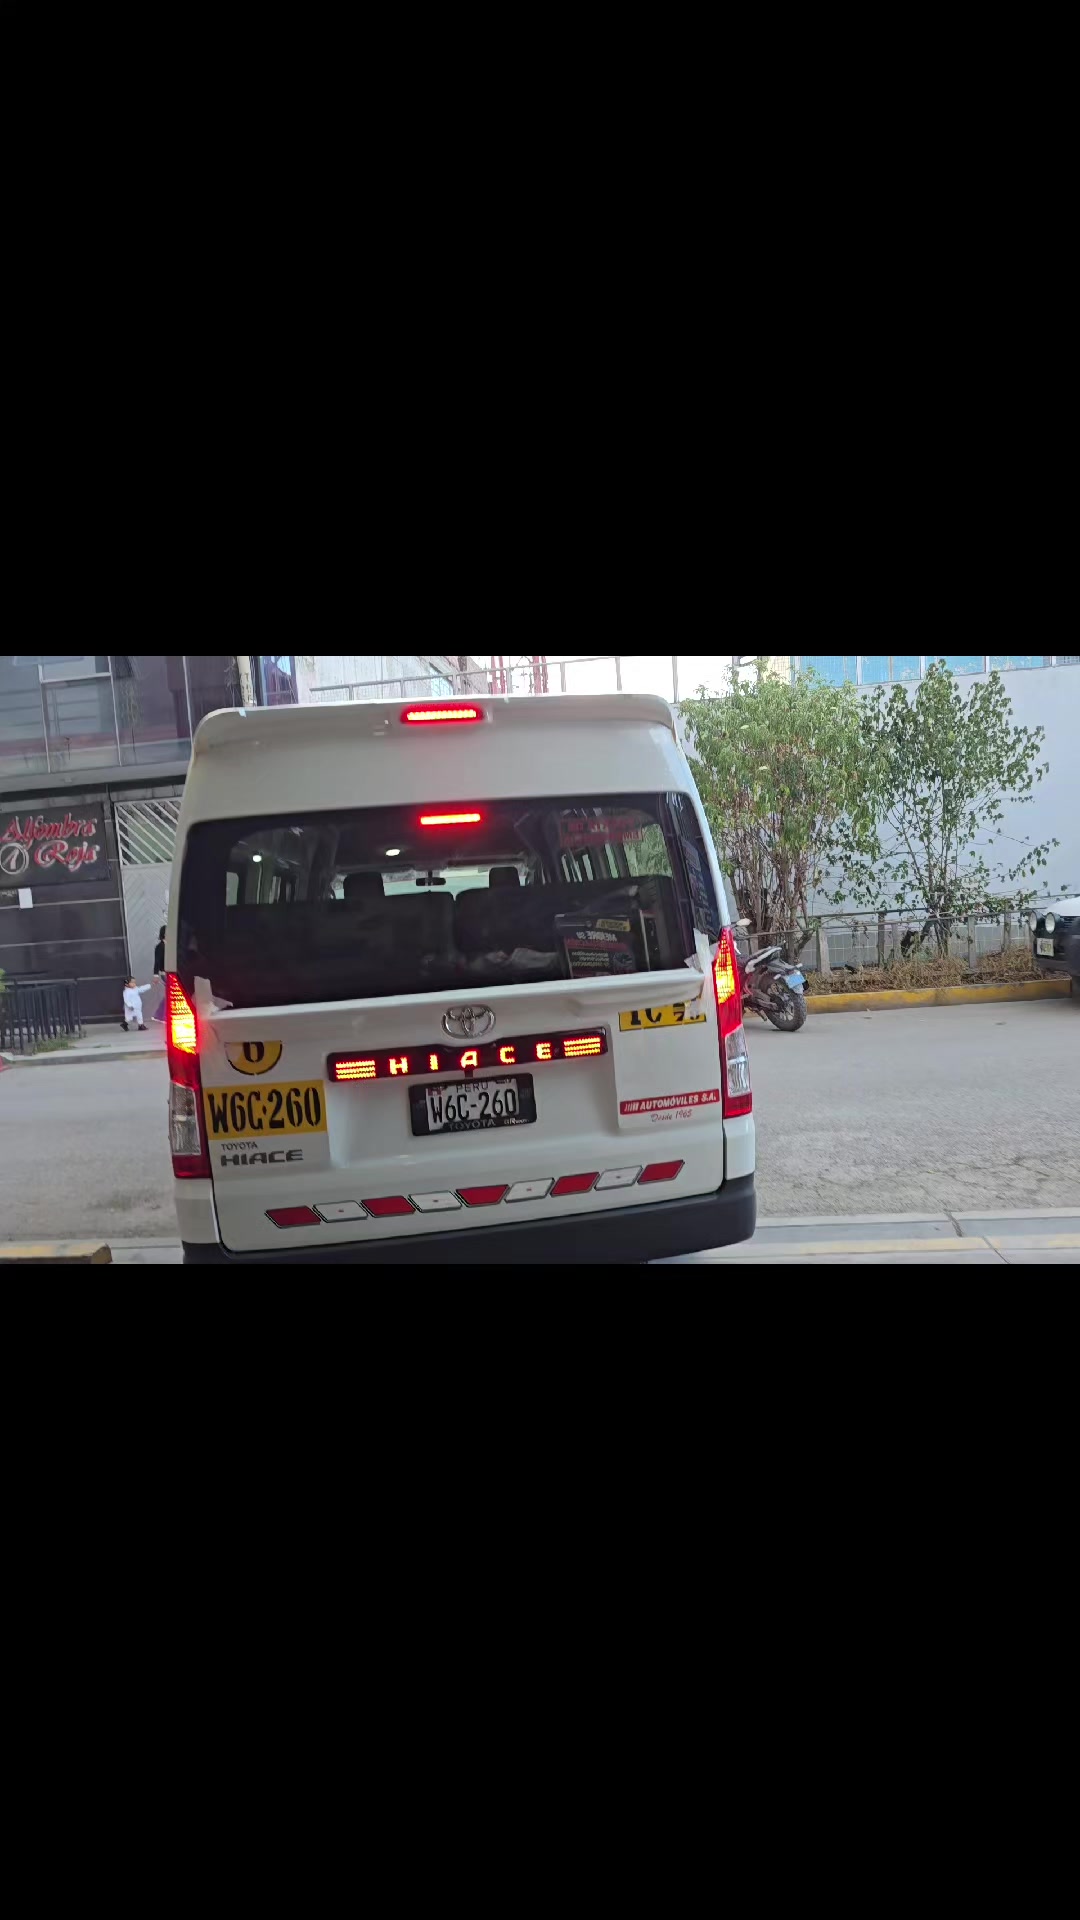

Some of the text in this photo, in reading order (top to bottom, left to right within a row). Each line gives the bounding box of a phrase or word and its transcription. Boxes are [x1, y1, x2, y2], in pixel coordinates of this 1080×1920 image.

[0, 813, 97, 850] Alfombra
[34, 840, 100, 872] Roja
[389, 1042, 552, 1075] HIACE
[430, 1088, 518, 1123] W6C-260
[449, 1118, 496, 1131] TOYOTA
[221, 1141, 258, 1151] TOYOTA
[221, 1149, 304, 1167] HIACE
